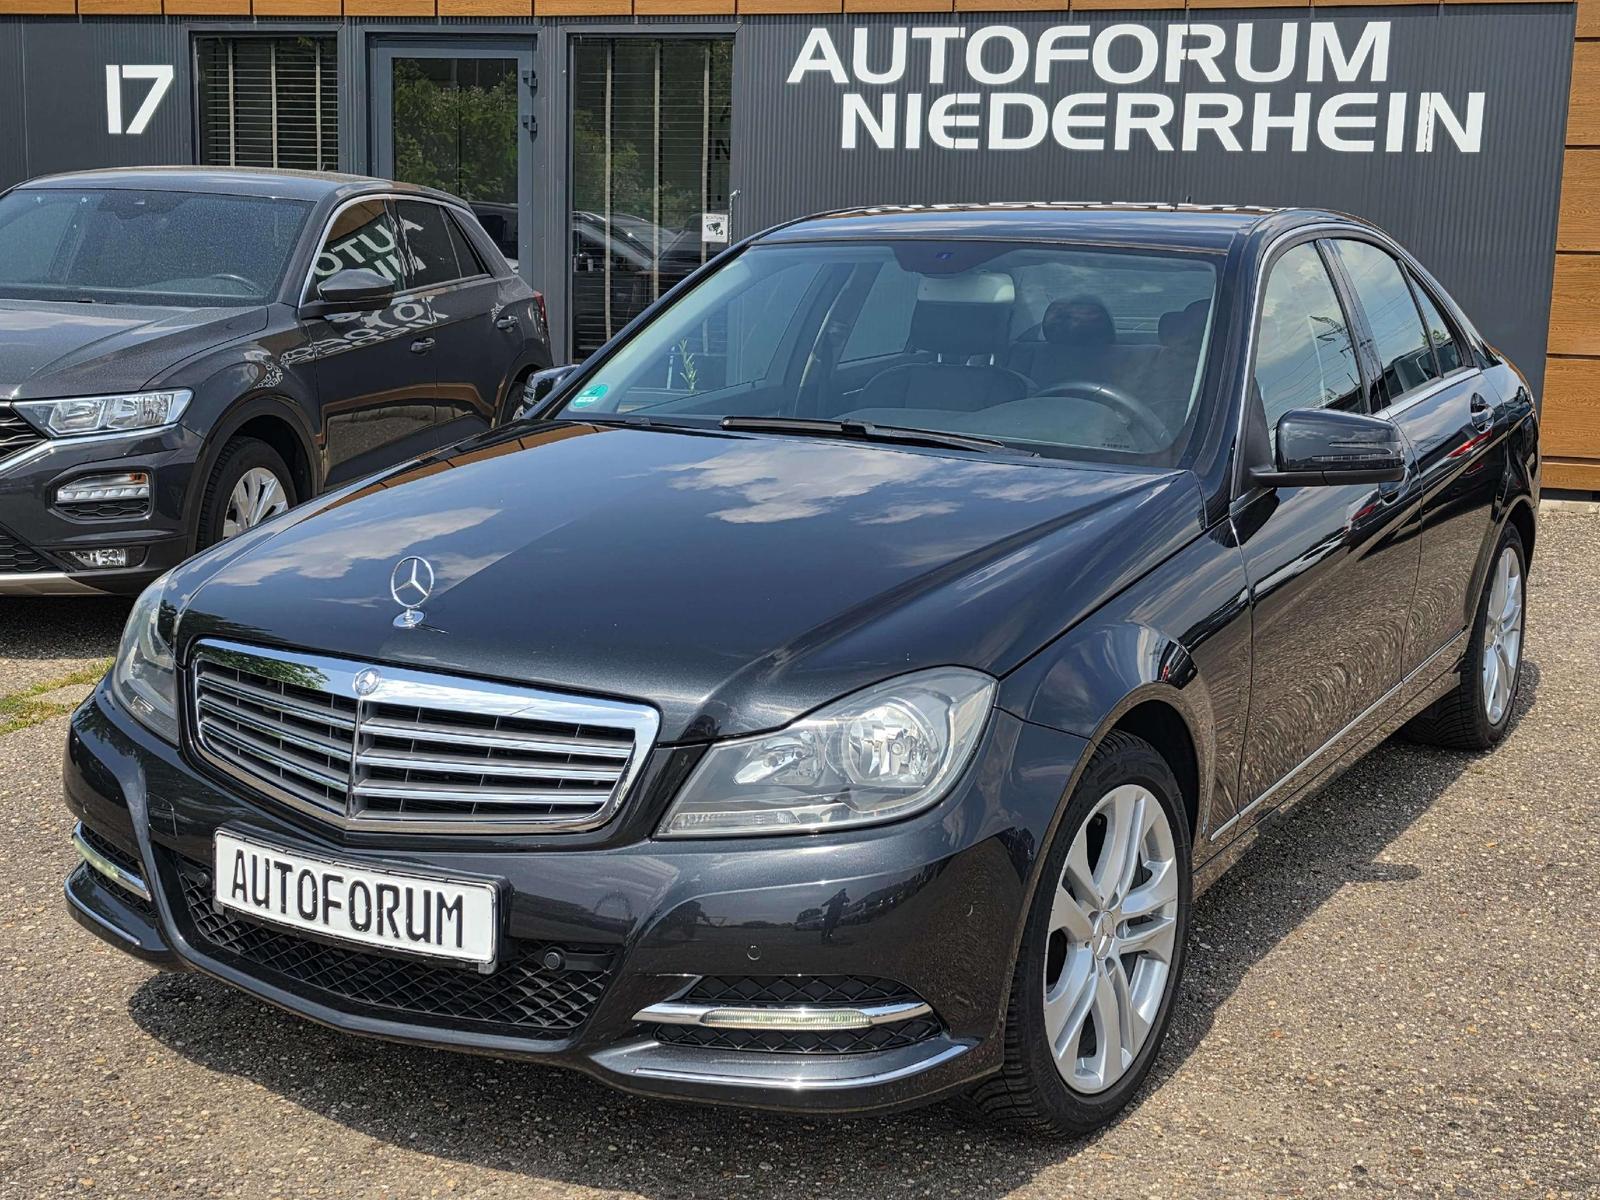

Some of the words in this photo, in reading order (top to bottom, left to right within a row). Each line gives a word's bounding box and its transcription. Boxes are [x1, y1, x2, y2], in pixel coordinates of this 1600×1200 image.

[786, 20, 1391, 85] AUTOFORUM
[105, 64, 174, 135] 17
[841, 91, 1486, 154] NIEDERRHEIN
[231, 848, 464, 949] AUTOFORUM
